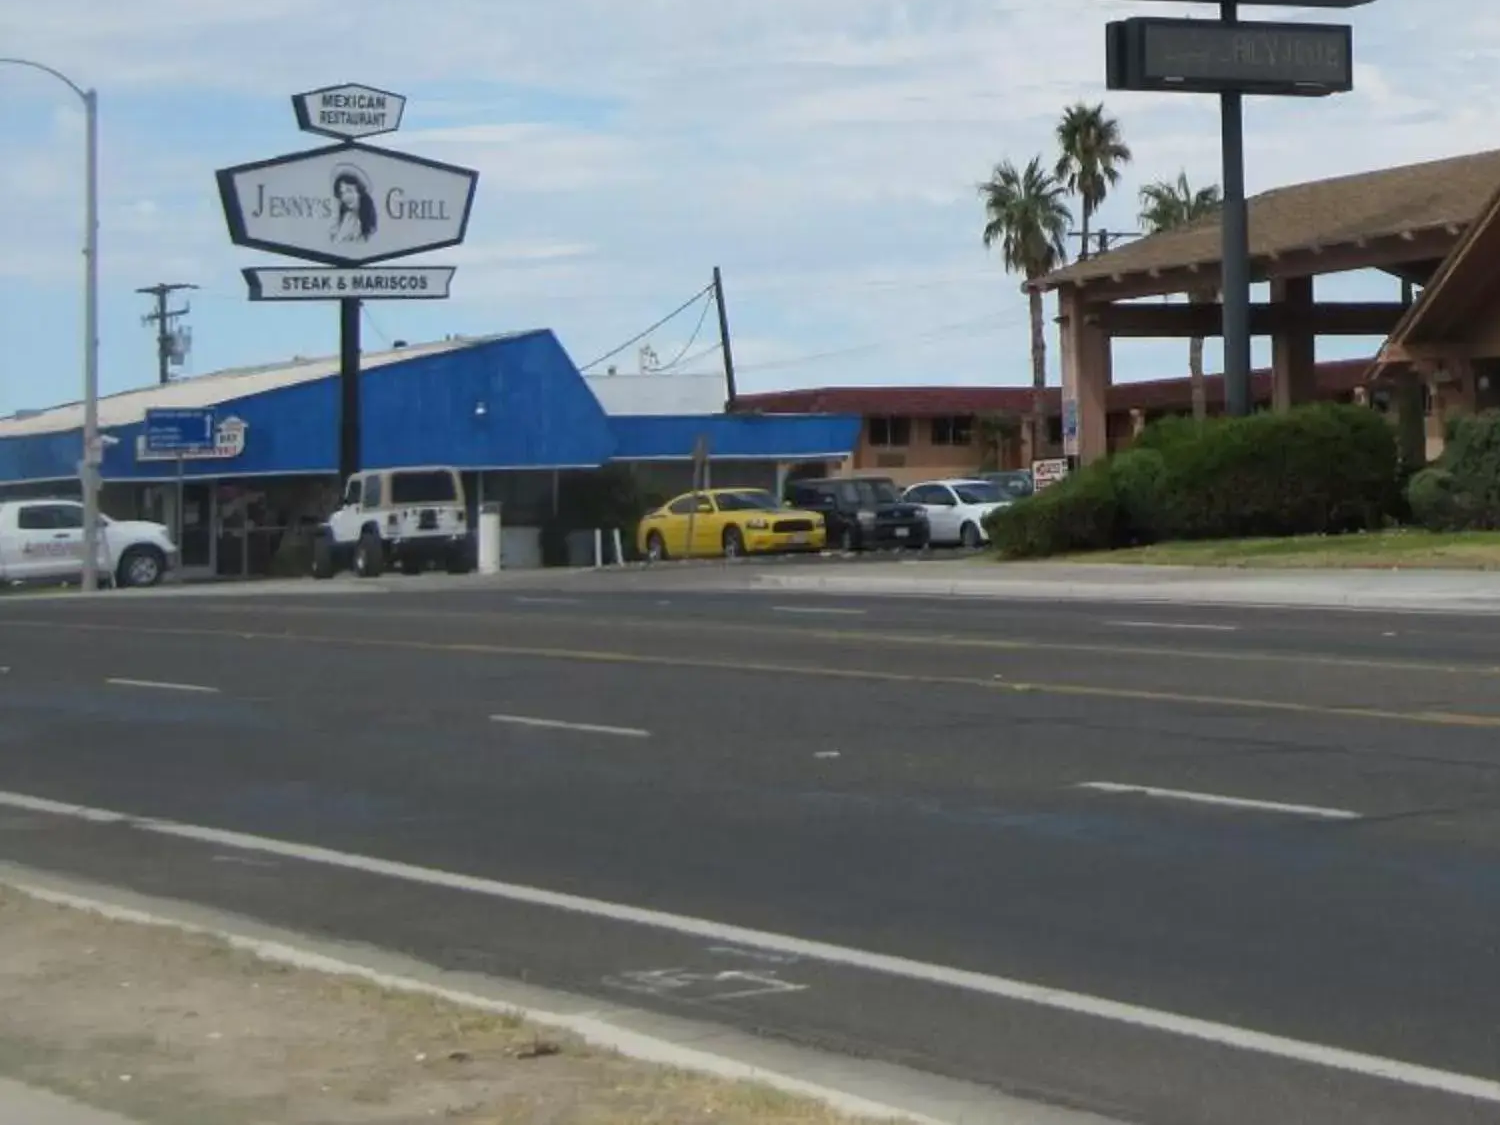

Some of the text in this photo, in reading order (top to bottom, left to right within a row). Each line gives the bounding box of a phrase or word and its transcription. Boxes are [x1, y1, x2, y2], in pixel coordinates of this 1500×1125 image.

[321, 94, 386, 109] MEXICAN
[319, 111, 386, 127] RESTAURANT
[251, 184, 451, 221] JENNY'S GRILL
[281, 276, 428, 290] STEAK & MARISCOS
